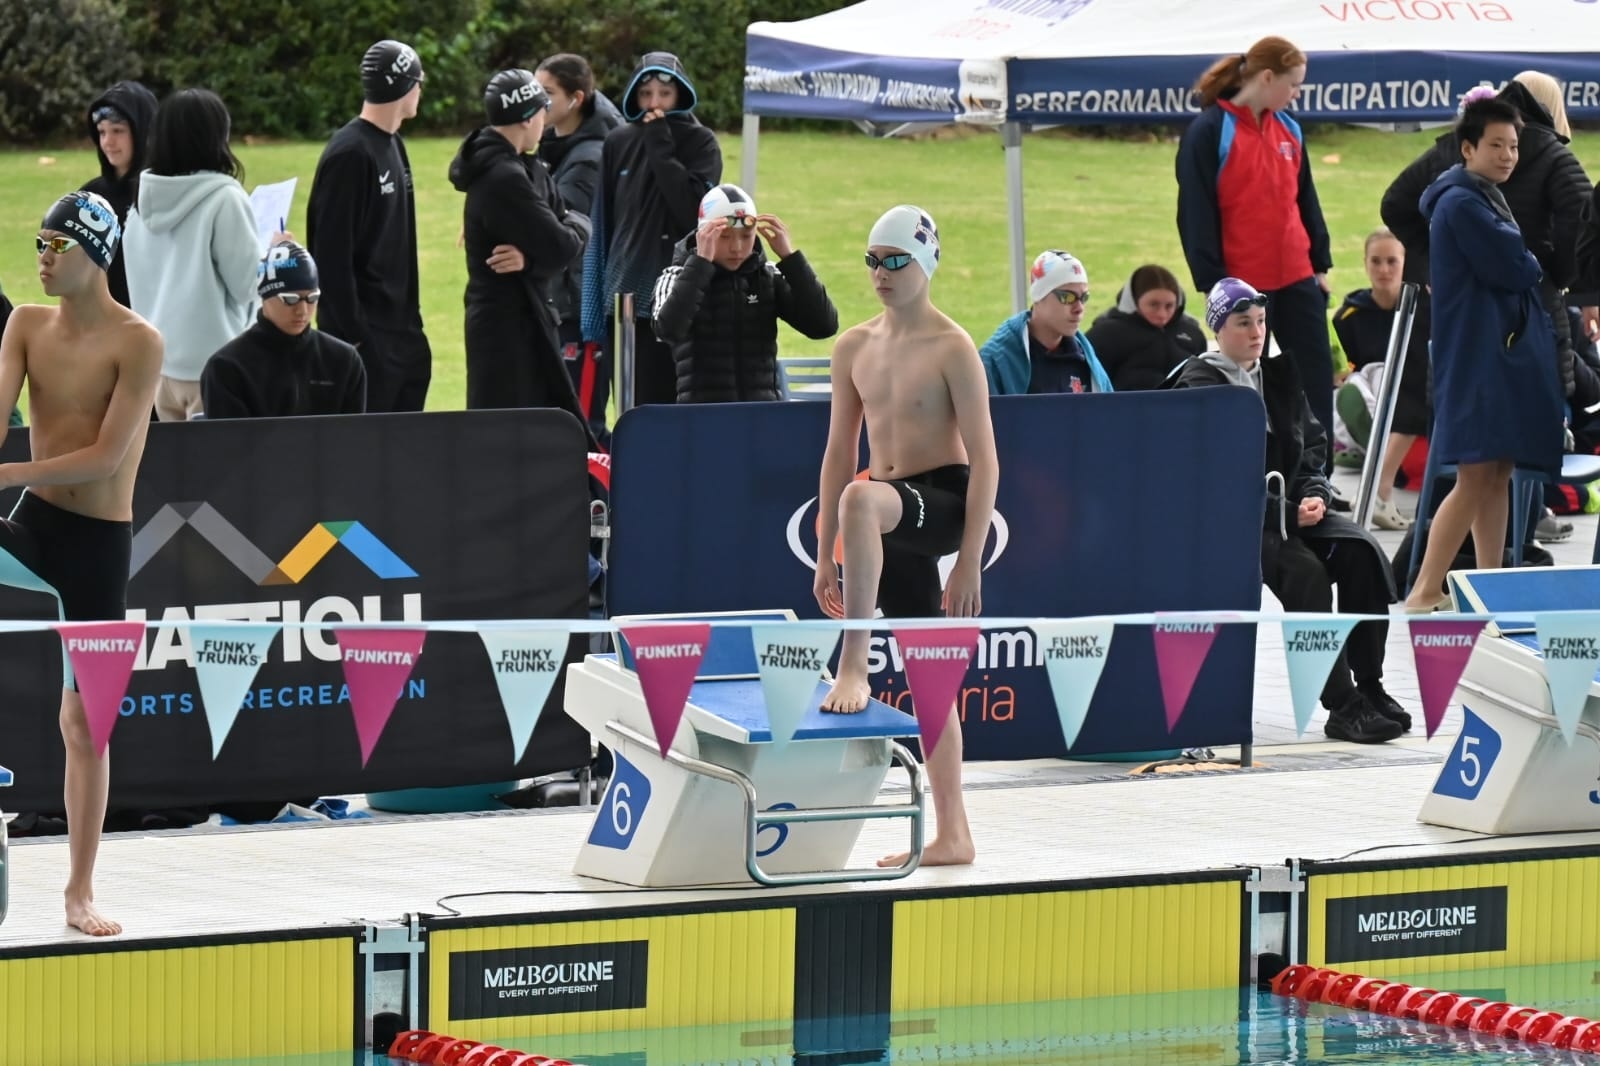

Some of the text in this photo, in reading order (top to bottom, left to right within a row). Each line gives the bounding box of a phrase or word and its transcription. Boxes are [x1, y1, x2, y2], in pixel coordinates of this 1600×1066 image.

[1015, 87, 1202, 113] PERFORMANC
[64, 220, 102, 248] STATE
[1052, 635, 1098, 648] FUNKY
[1294, 630, 1339, 640] FUNKY
[1414, 635, 1473, 647] FUNKITA
[68, 638, 136, 652] FUNKITA
[203, 639, 256, 653] FUNKY
[1287, 640, 1339, 652] TRUNKS
[1549, 637, 1596, 648] FUNKY
[344, 649, 412, 665] FUNKITA
[502, 649, 552, 661] FUNKY
[635, 643, 701, 660] FUNKITA
[766, 643, 819, 657] FUNKY
[905, 646, 968, 660] FUNKITA
[1046, 647, 1103, 659] TRUNKS
[1543, 648, 1599, 660] TRUNKS
[196, 651, 258, 666] TRUNKS
[760, 654, 821, 671] TRUNKS
[495, 660, 556, 672] TRUNKS
[1459, 735, 1481, 788] 5
[612, 782, 632, 836] 6
[1358, 905, 1477, 933] MELBOURNE
[1371, 928, 1463, 942] EVERY BIT DIFFERENT
[484, 960, 614, 988] MELBOURNE
[498, 984, 598, 998] EVERY BIT DIFFERENT
